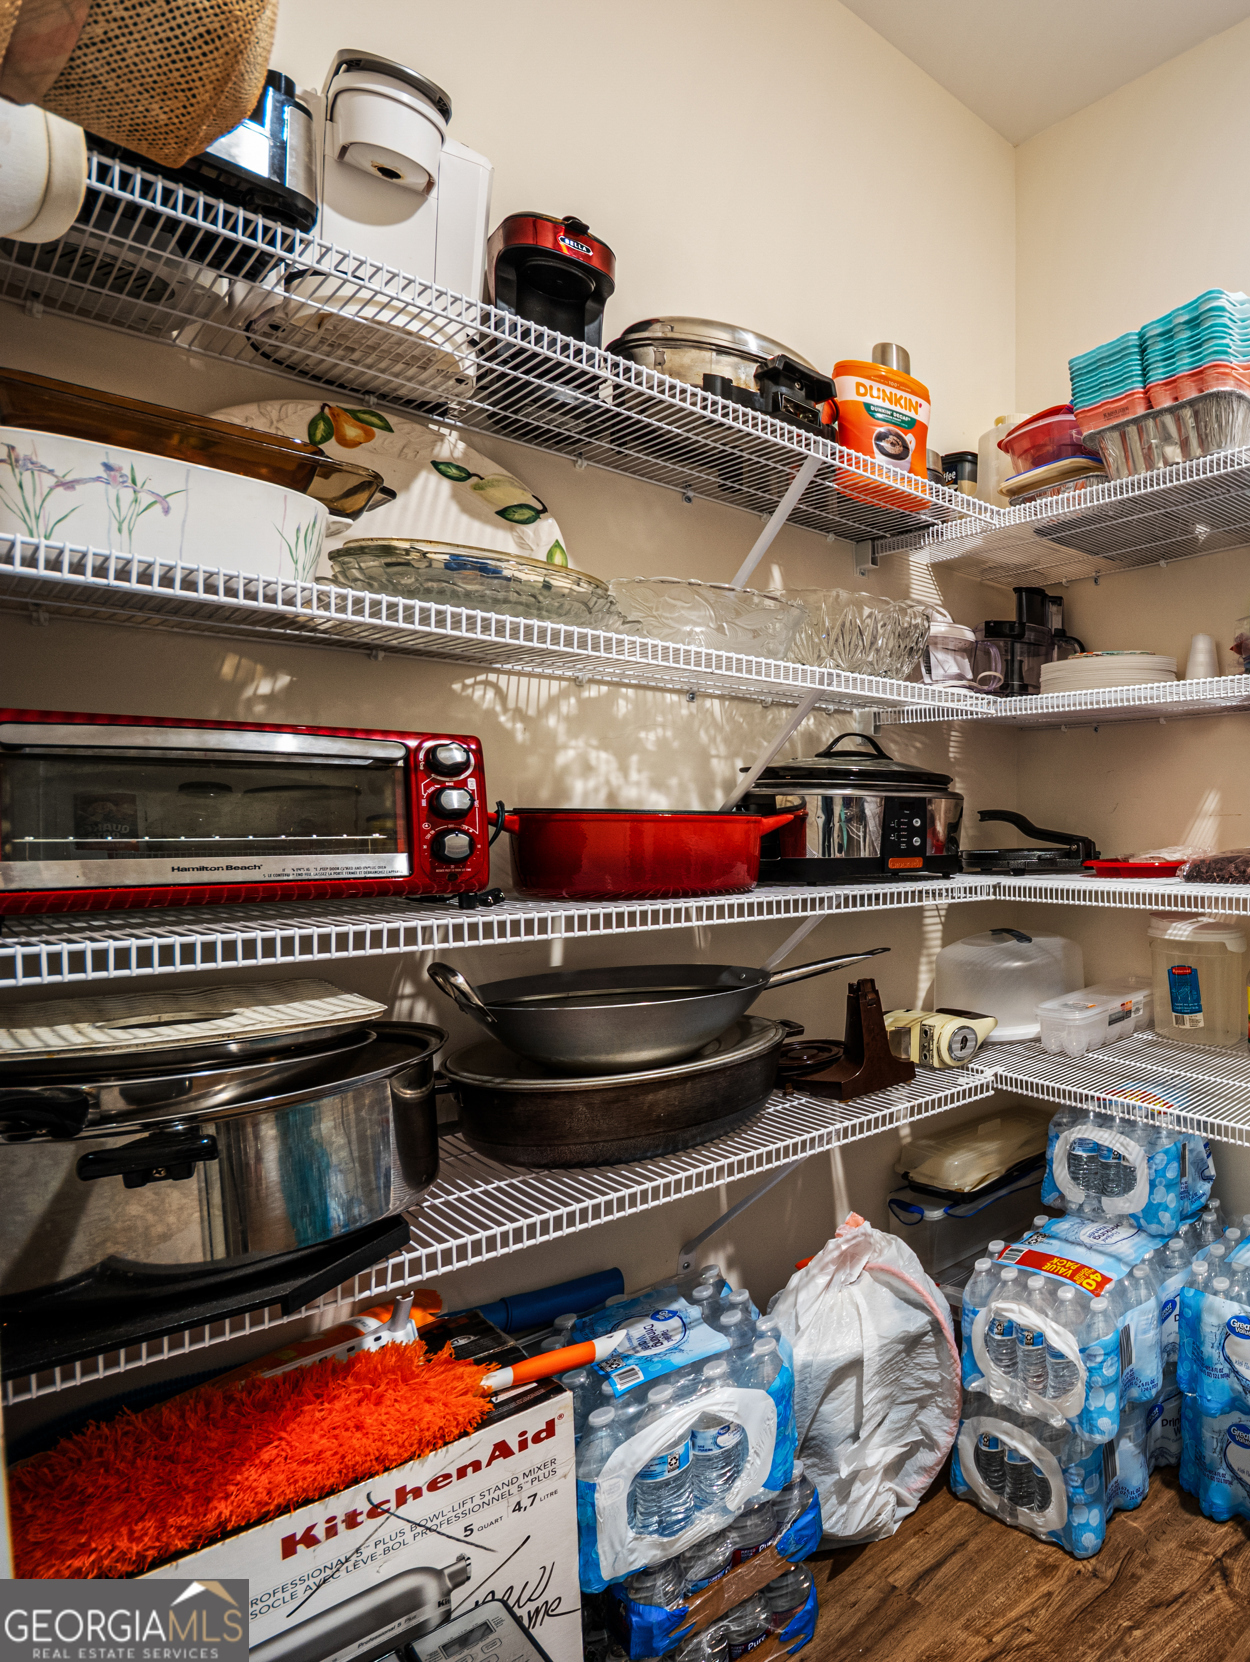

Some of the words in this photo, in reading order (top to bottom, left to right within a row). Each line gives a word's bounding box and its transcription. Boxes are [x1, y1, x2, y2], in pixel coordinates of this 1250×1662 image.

[564, 238, 587, 251] BELLA
[855, 381, 922, 416] DUNKIN'
[171, 865, 223, 873] Hamilton
[224, 864, 262, 872] Beach
[1042, 1262, 1072, 1277] VALUE
[1050, 1257, 1081, 1269] PACK
[1082, 1272, 1102, 1291] 40
[280, 1417, 557, 1561] KitchenAid
[477, 1515, 504, 1532] QUART
[511, 1491, 539, 1515] 4,7
[539, 1489, 559, 1503] LITRE
[250, 1554, 353, 1609] ROFESSIONAL
[374, 1529, 406, 1549] PLUS
[409, 1493, 476, 1534] BOWL-LIFT
[479, 1476, 519, 1503] STAND
[522, 1458, 557, 1483] MIXER
[250, 1592, 299, 1620] SOCLE
[303, 1570, 341, 1594] AVEC
[346, 1539, 410, 1574] LÈVE-BOL
[412, 1489, 515, 1541] PROFESSIONNEL
[530, 1468, 558, 1487] PLUS
[357, 1623, 397, 1649] Professional
